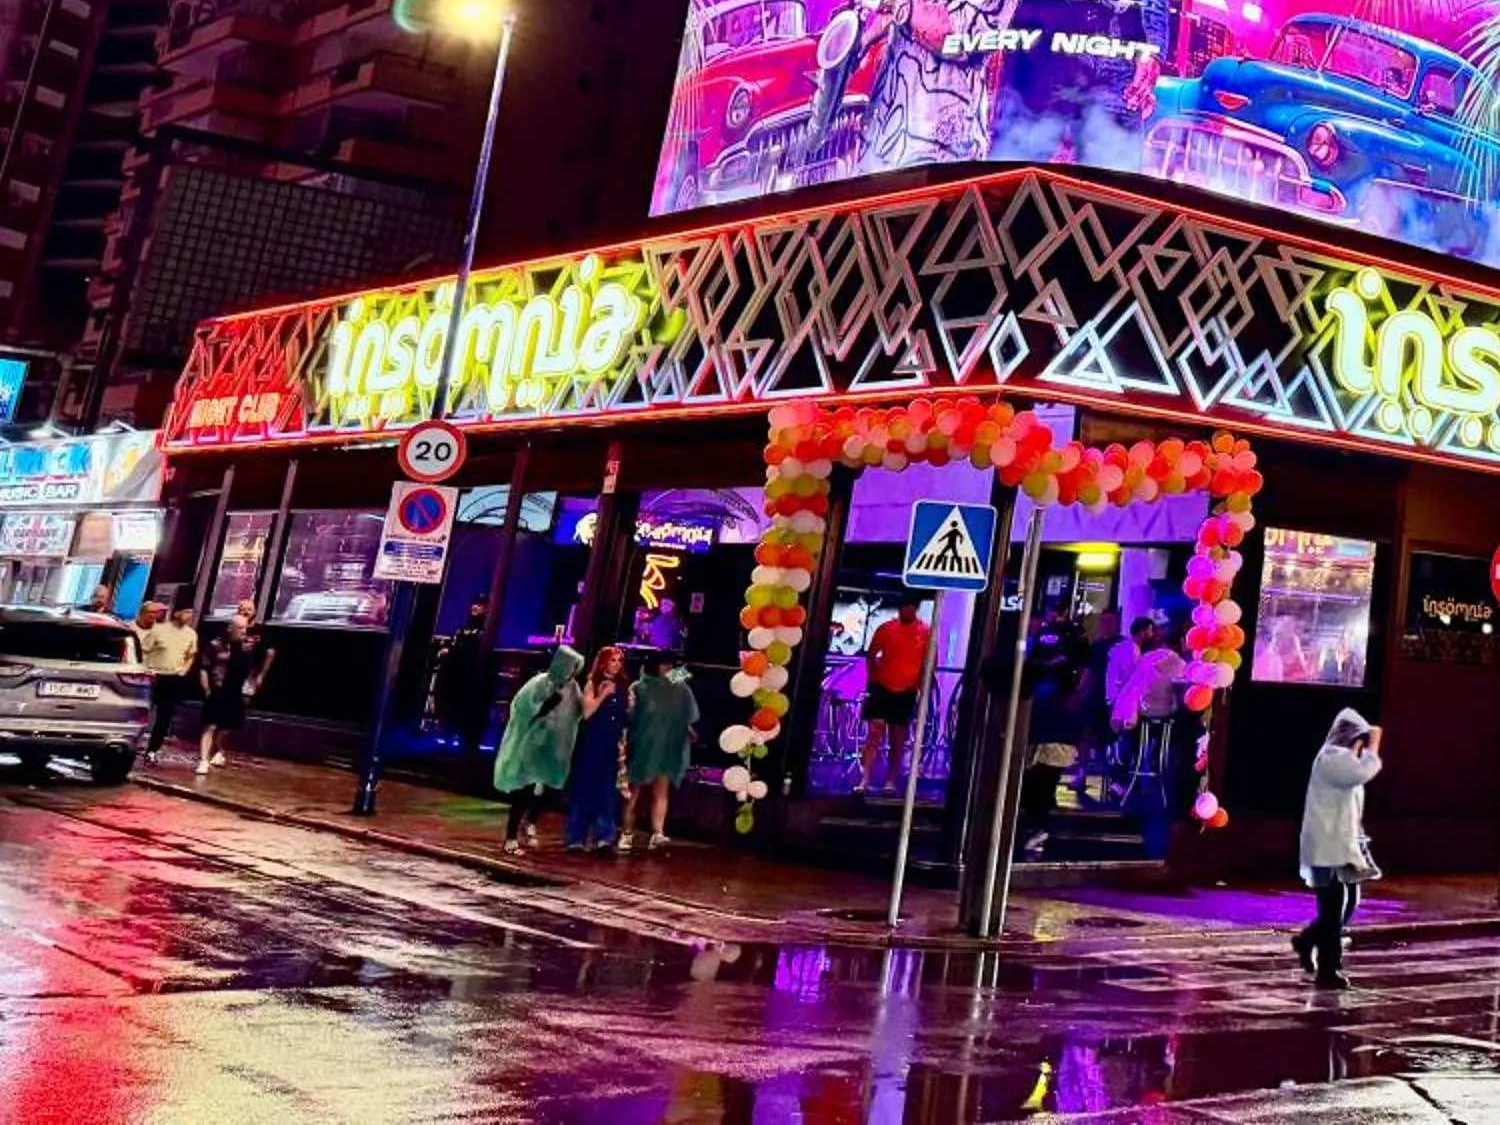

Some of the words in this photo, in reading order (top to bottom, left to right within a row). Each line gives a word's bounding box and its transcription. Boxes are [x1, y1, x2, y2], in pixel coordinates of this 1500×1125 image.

[942, 28, 1042, 55] EVERY
[1051, 31, 1161, 64] NIGHT
[189, 395, 238, 428] NIGHT
[238, 391, 280, 424] CLUB
[414, 440, 452, 462] 20
